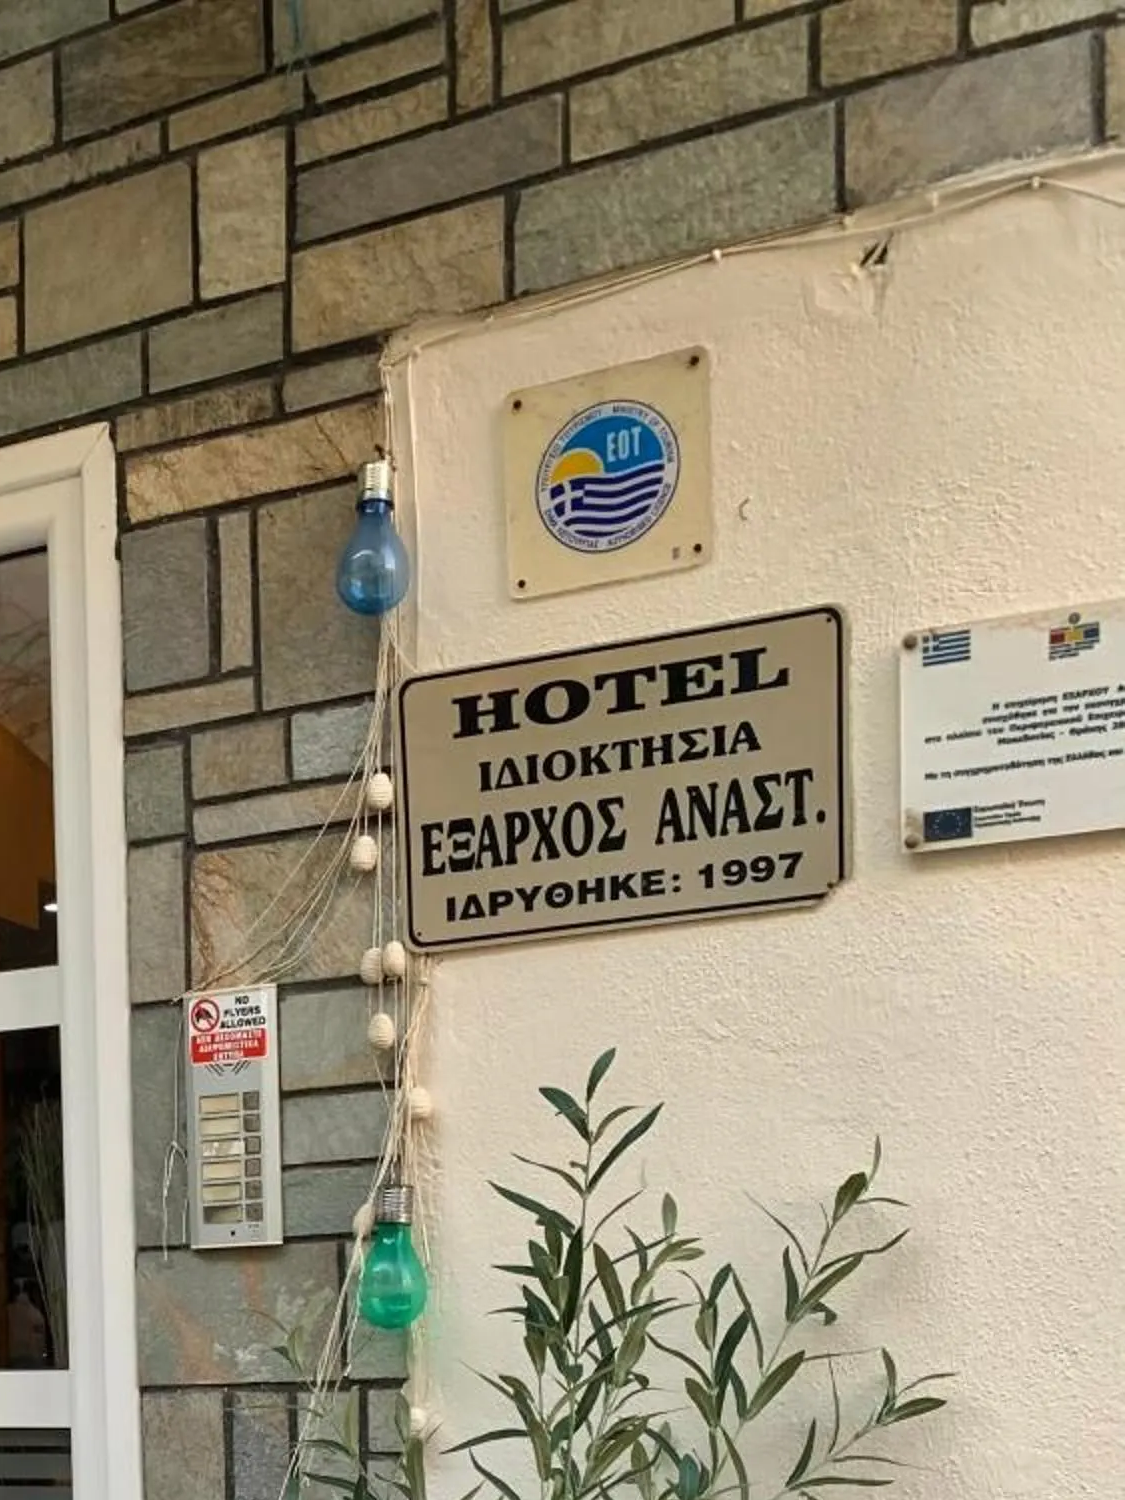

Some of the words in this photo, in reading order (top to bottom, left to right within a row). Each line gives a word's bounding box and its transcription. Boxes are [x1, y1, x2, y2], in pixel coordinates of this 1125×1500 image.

[451, 647, 790, 739] HOTEL
[478, 720, 762, 793] ΙΔΙΟΚΤΗΣΙΑ
[420, 796, 628, 877] ΕΞΑΡΧΟΣ
[654, 768, 827, 846] ΑΝΑΣΤ.
[445, 868, 683, 923] ΙΔΡΥΘΗΚΕ:
[697, 851, 805, 890] 1997
[220, 1016, 266, 1028] ALLOWED
[224, 1005, 262, 1017] FLYERS
[235, 996, 250, 1005] NO
